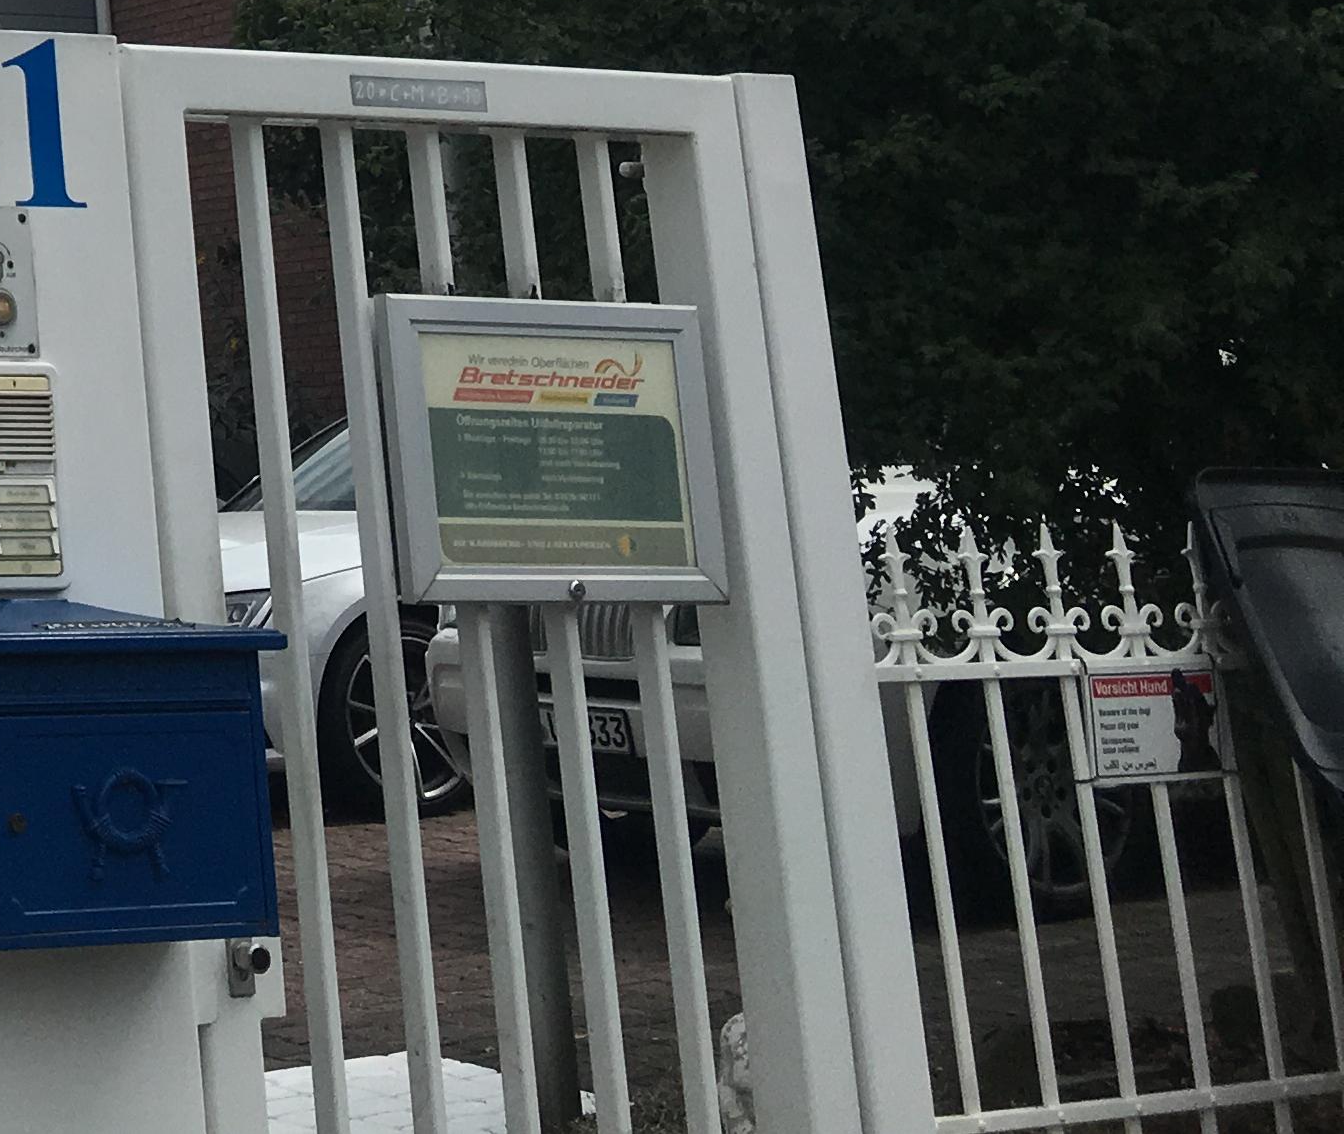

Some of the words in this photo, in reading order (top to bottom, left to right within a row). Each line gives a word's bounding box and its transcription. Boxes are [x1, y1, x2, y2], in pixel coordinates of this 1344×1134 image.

[468, 353, 485, 365] Wir
[459, 366, 645, 391] Bretschneider
[1095, 681, 1138, 695] Vorsicht
[1140, 679, 1168, 694] Hund
